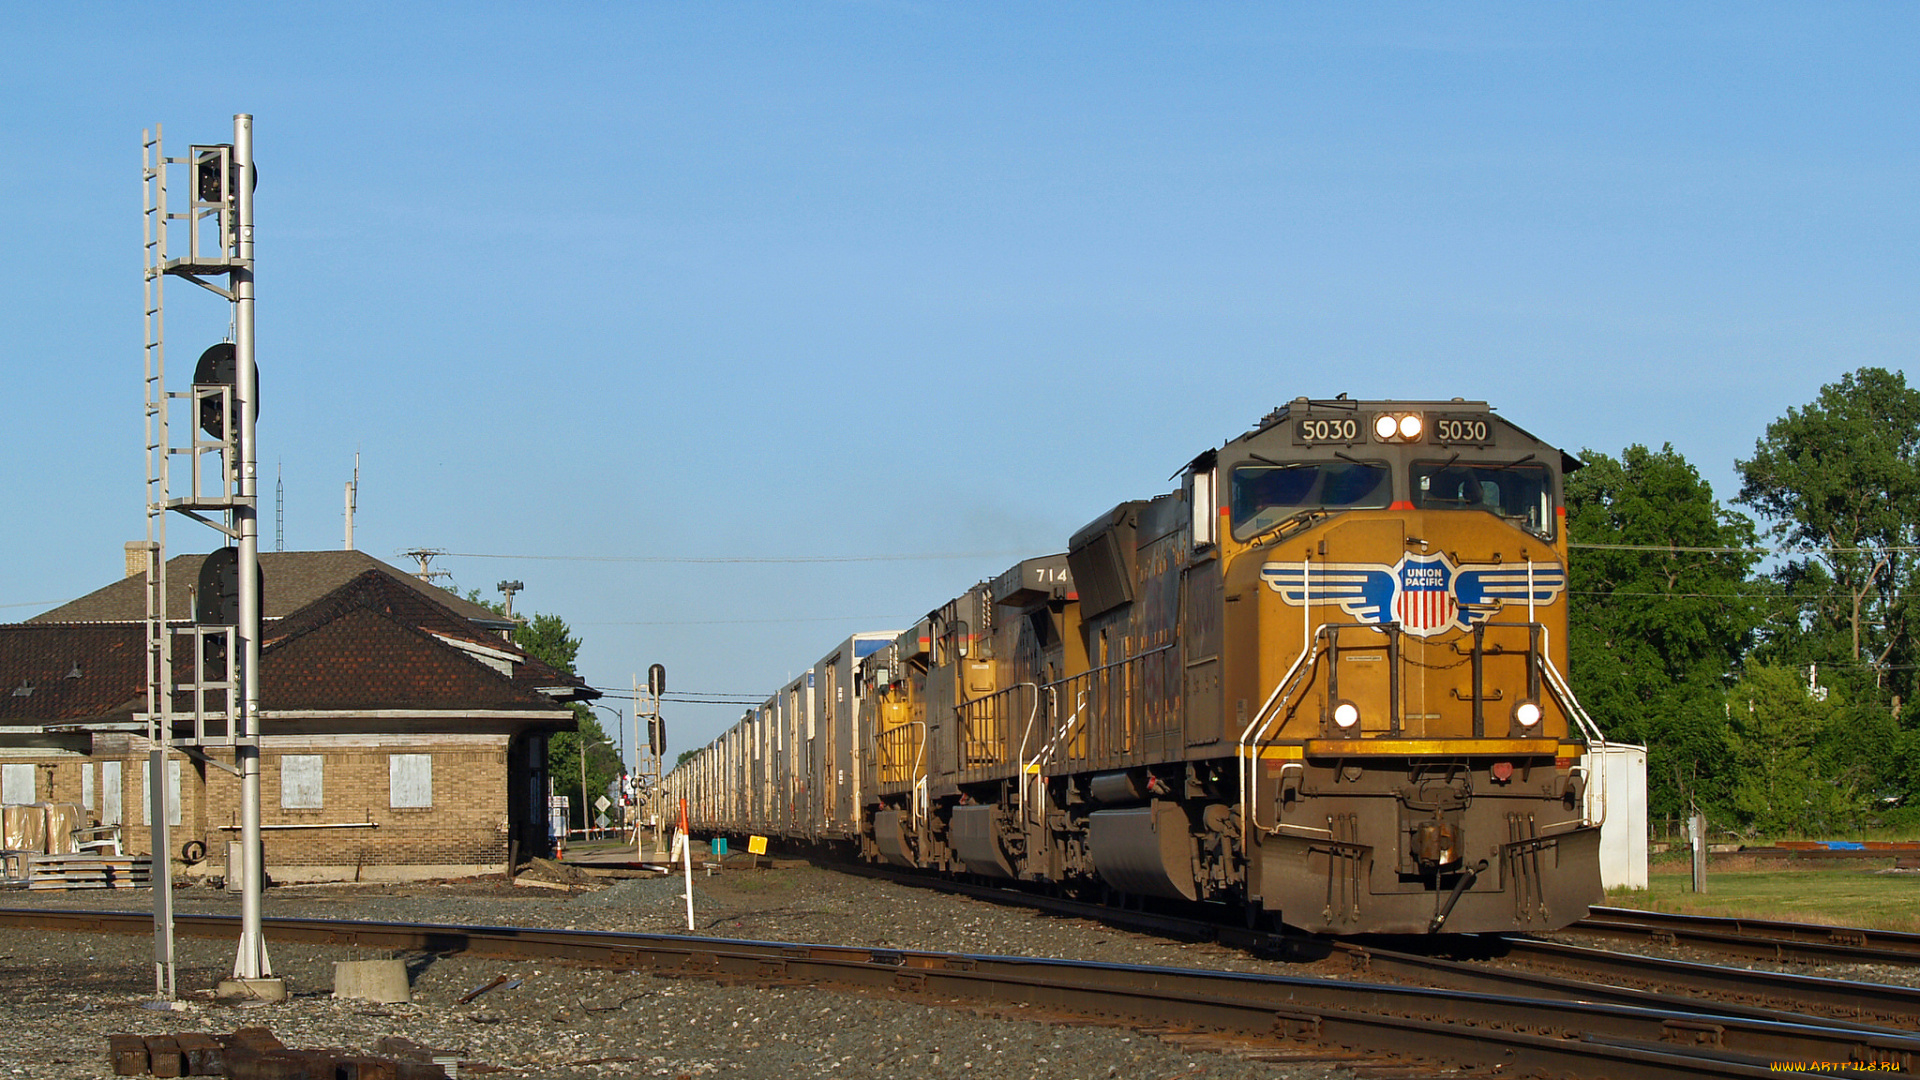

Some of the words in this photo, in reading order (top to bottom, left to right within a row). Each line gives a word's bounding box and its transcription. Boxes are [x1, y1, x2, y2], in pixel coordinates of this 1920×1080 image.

[1302, 420, 1357, 440] 5030
[1438, 420, 1487, 441] 5030
[1036, 568, 1074, 583] 714
[1407, 568, 1442, 578] UNION
[1405, 577, 1444, 586] PACIFIC
